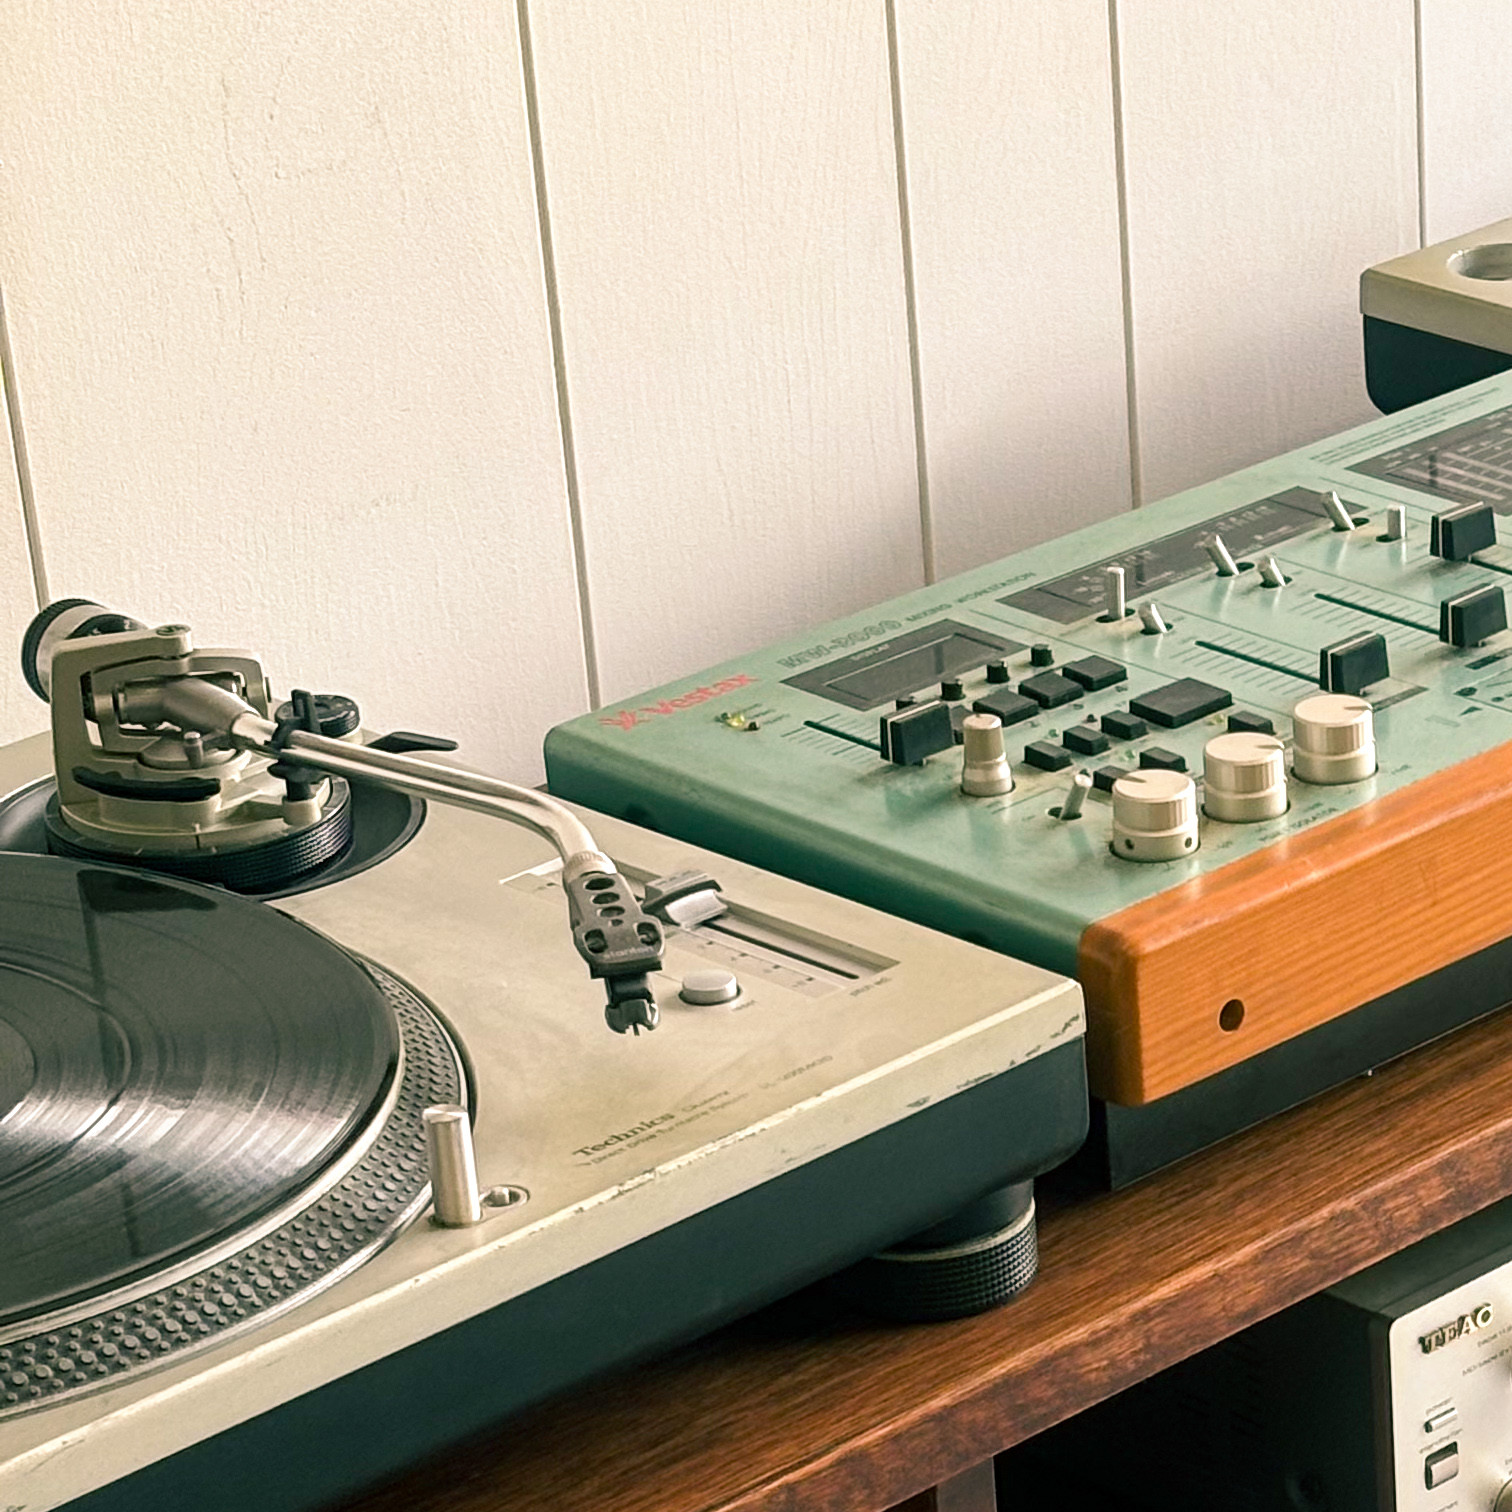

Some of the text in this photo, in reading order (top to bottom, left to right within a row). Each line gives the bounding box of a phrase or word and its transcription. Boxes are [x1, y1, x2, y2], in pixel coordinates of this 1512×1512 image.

[638, 674, 757, 717] Vestax
[571, 1112, 675, 1159] Technics
[1418, 1302, 1495, 1354] TEAC
